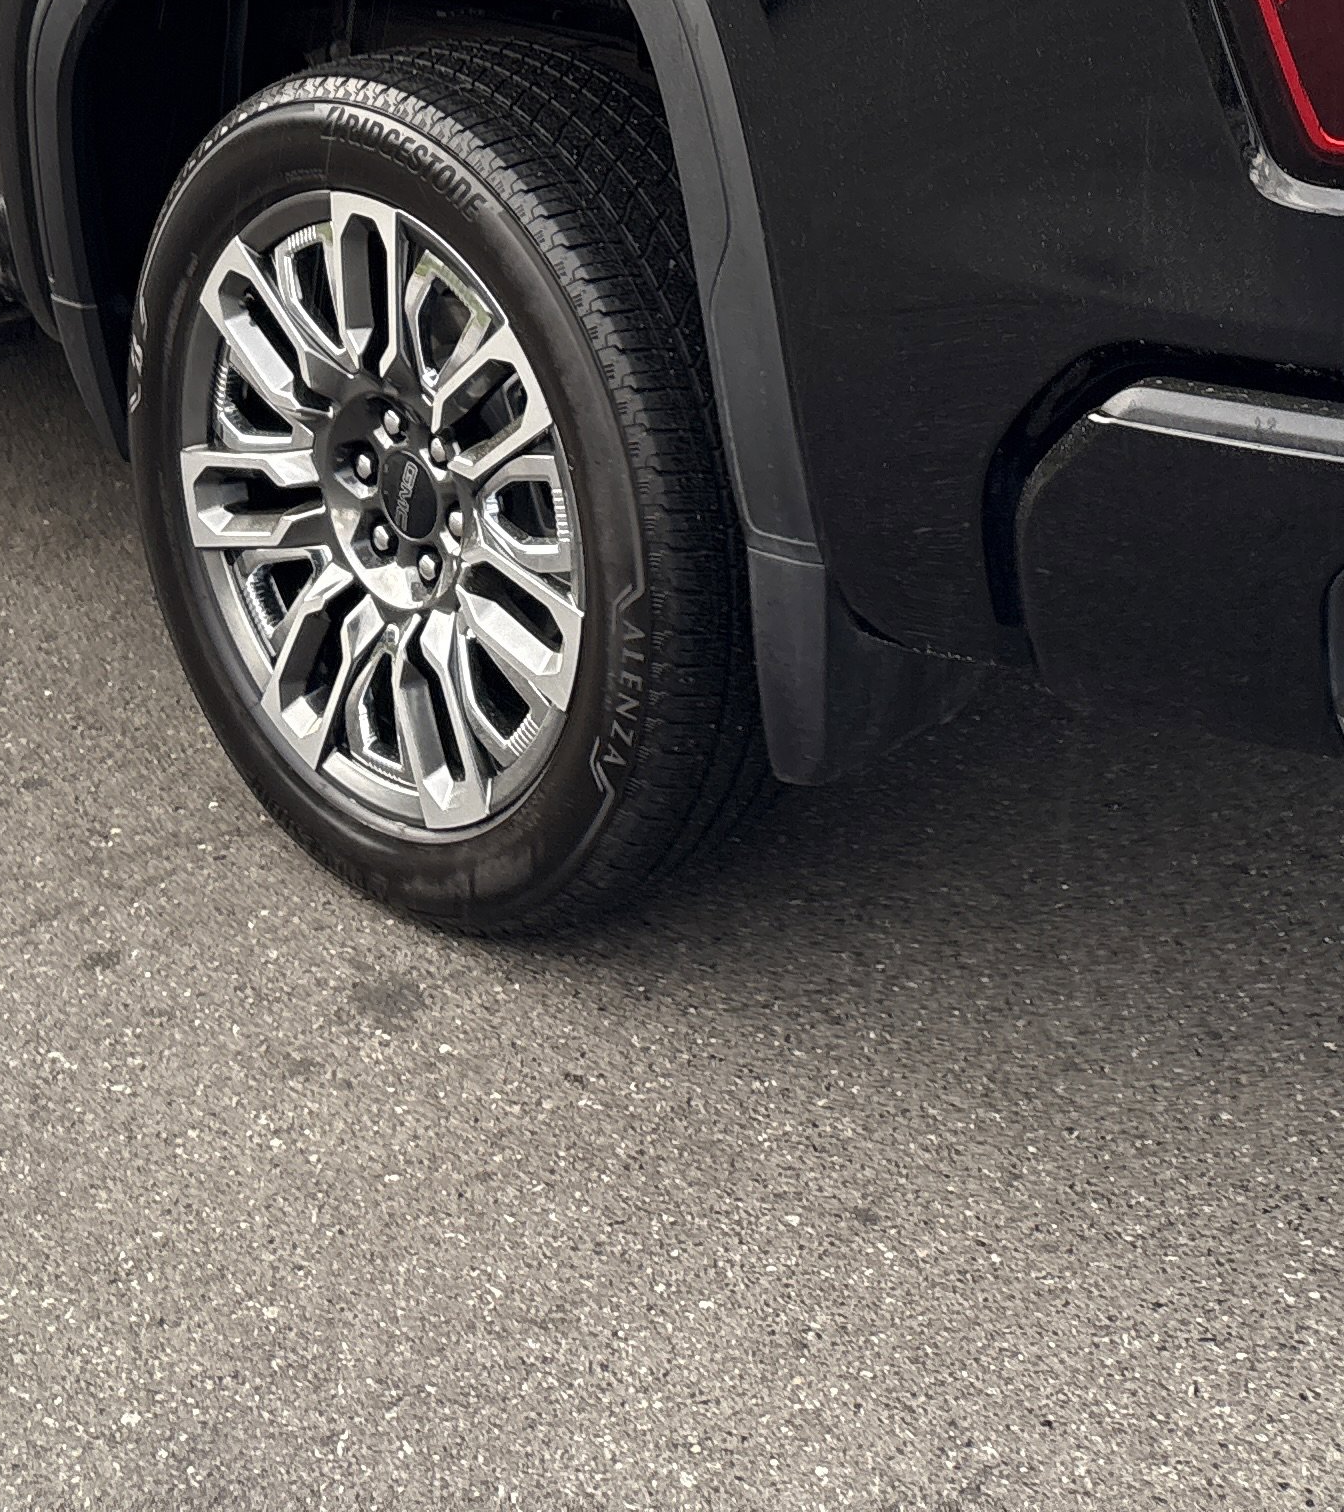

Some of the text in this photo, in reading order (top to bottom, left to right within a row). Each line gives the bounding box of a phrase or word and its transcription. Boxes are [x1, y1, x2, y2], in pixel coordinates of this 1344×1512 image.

[324, 105, 488, 223] BRIDGESTONE
[396, 461, 418, 531] GMC
[603, 619, 646, 768] ALENZA
